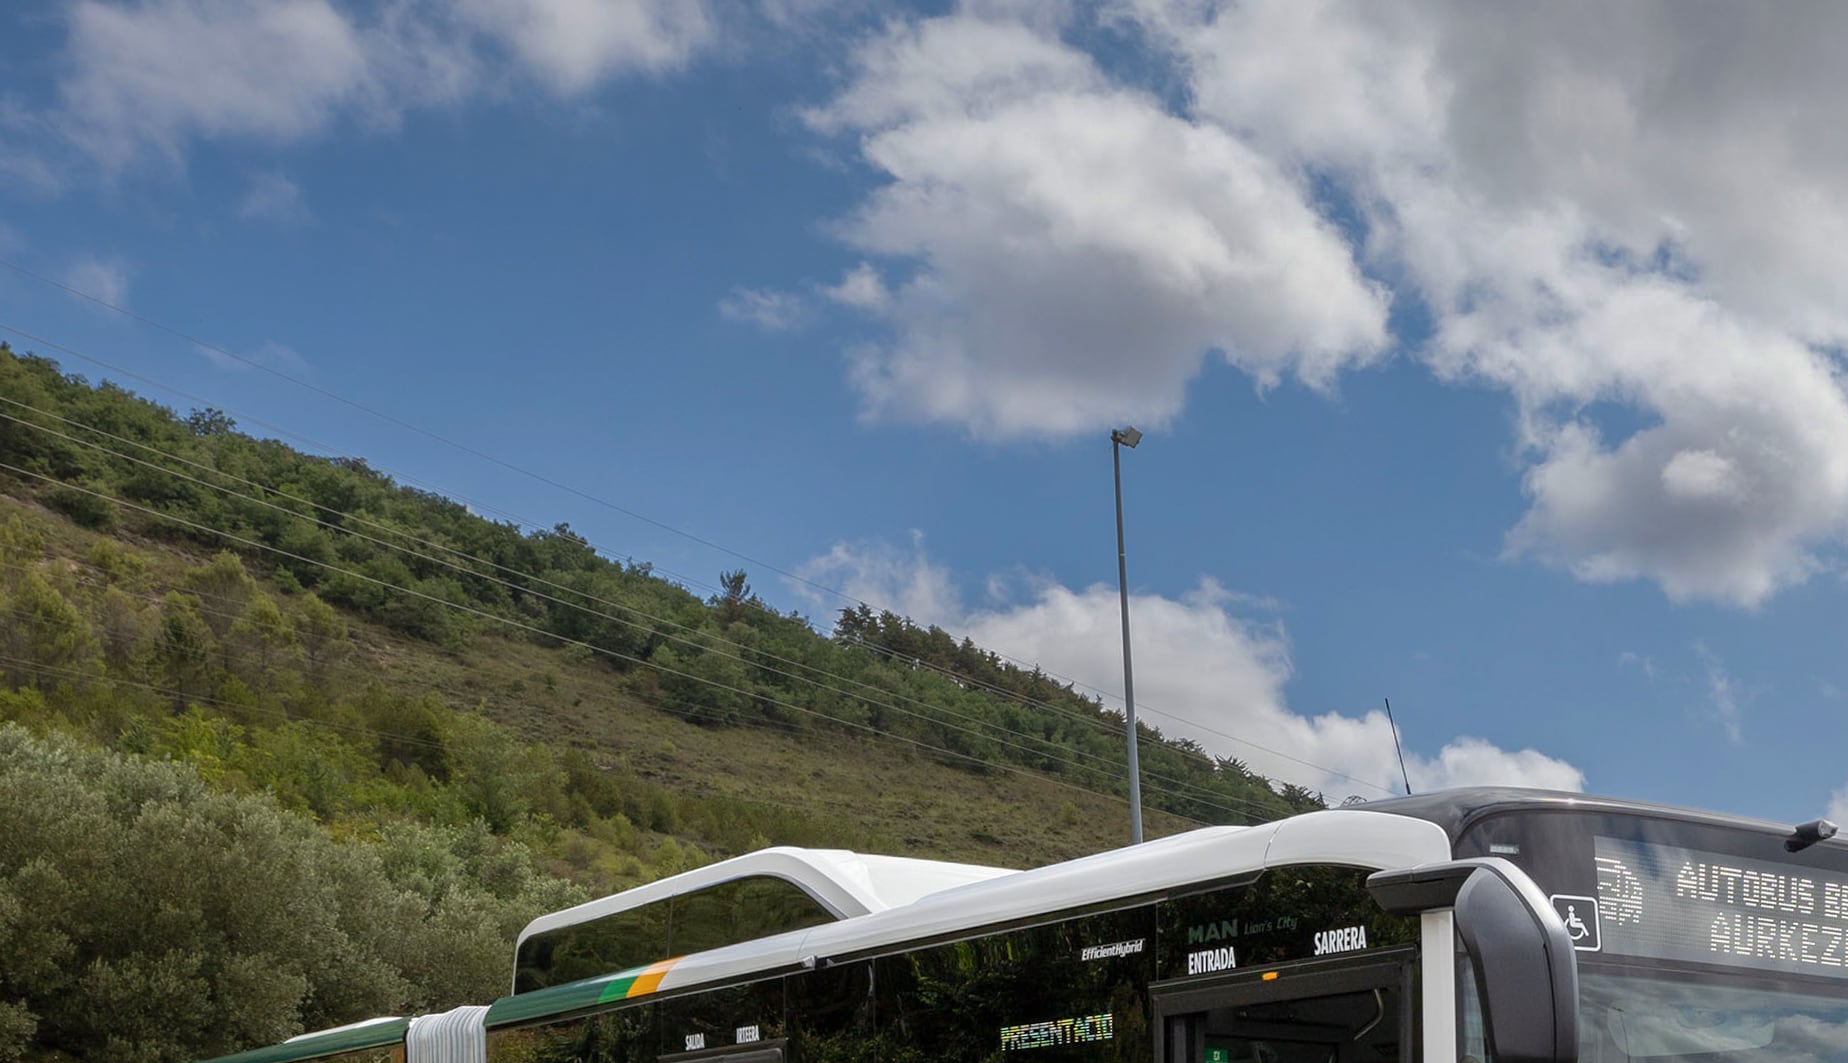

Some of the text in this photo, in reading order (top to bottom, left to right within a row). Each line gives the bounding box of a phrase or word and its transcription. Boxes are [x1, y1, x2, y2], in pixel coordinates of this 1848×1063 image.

[1677, 862, 1815, 914] AUTOBUS
[1188, 919, 1239, 945] MAN
[1314, 925, 1367, 956] SARRERA
[1081, 939, 1144, 961] EfficientHybrid
[1188, 946, 1237, 975] ENTRADA
[685, 1032, 706, 1051] SALIDA
